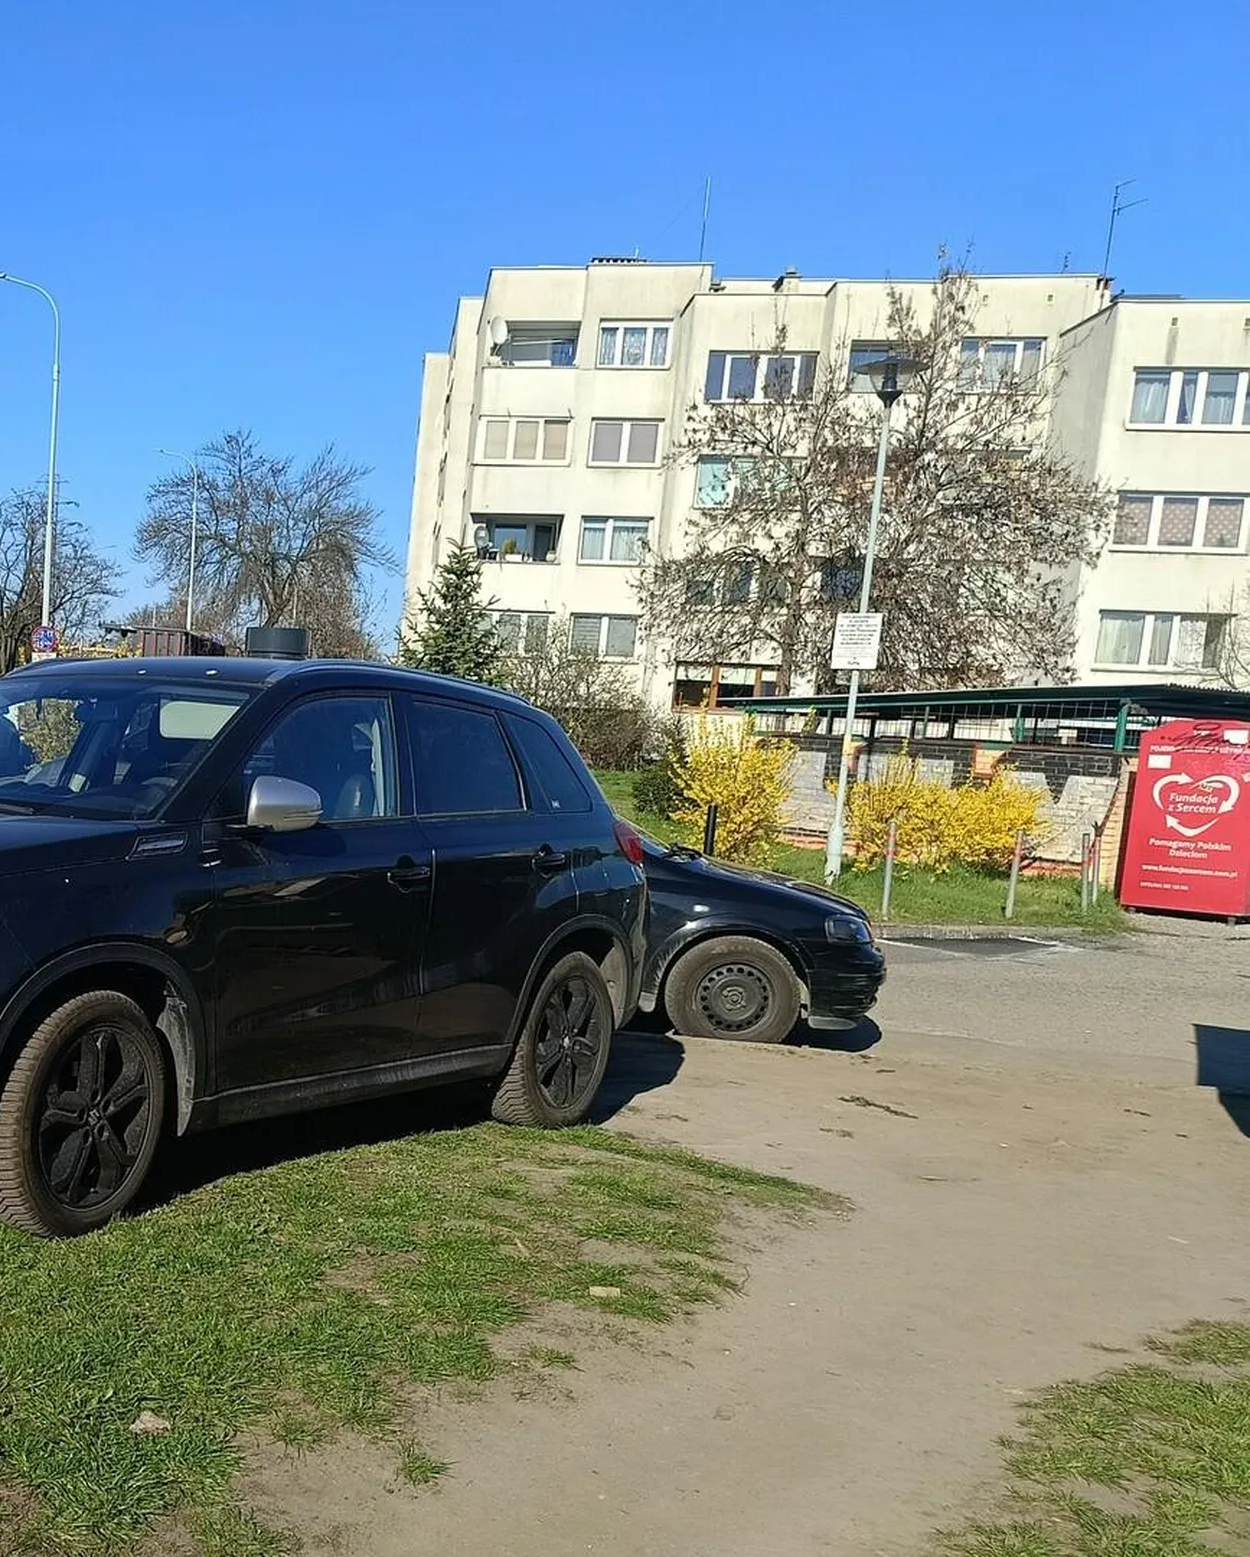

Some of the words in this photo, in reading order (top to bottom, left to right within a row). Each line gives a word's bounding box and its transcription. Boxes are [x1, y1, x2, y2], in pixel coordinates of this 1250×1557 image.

[1169, 792, 1219, 805] Fundacja
[1168, 804, 1174, 812] z
[1176, 803, 1217, 814] Sercem
[1149, 838, 1196, 850] Pomagamy
[1196, 841, 1232, 851] Polskim
[1169, 849, 1208, 859] Dzieciom
